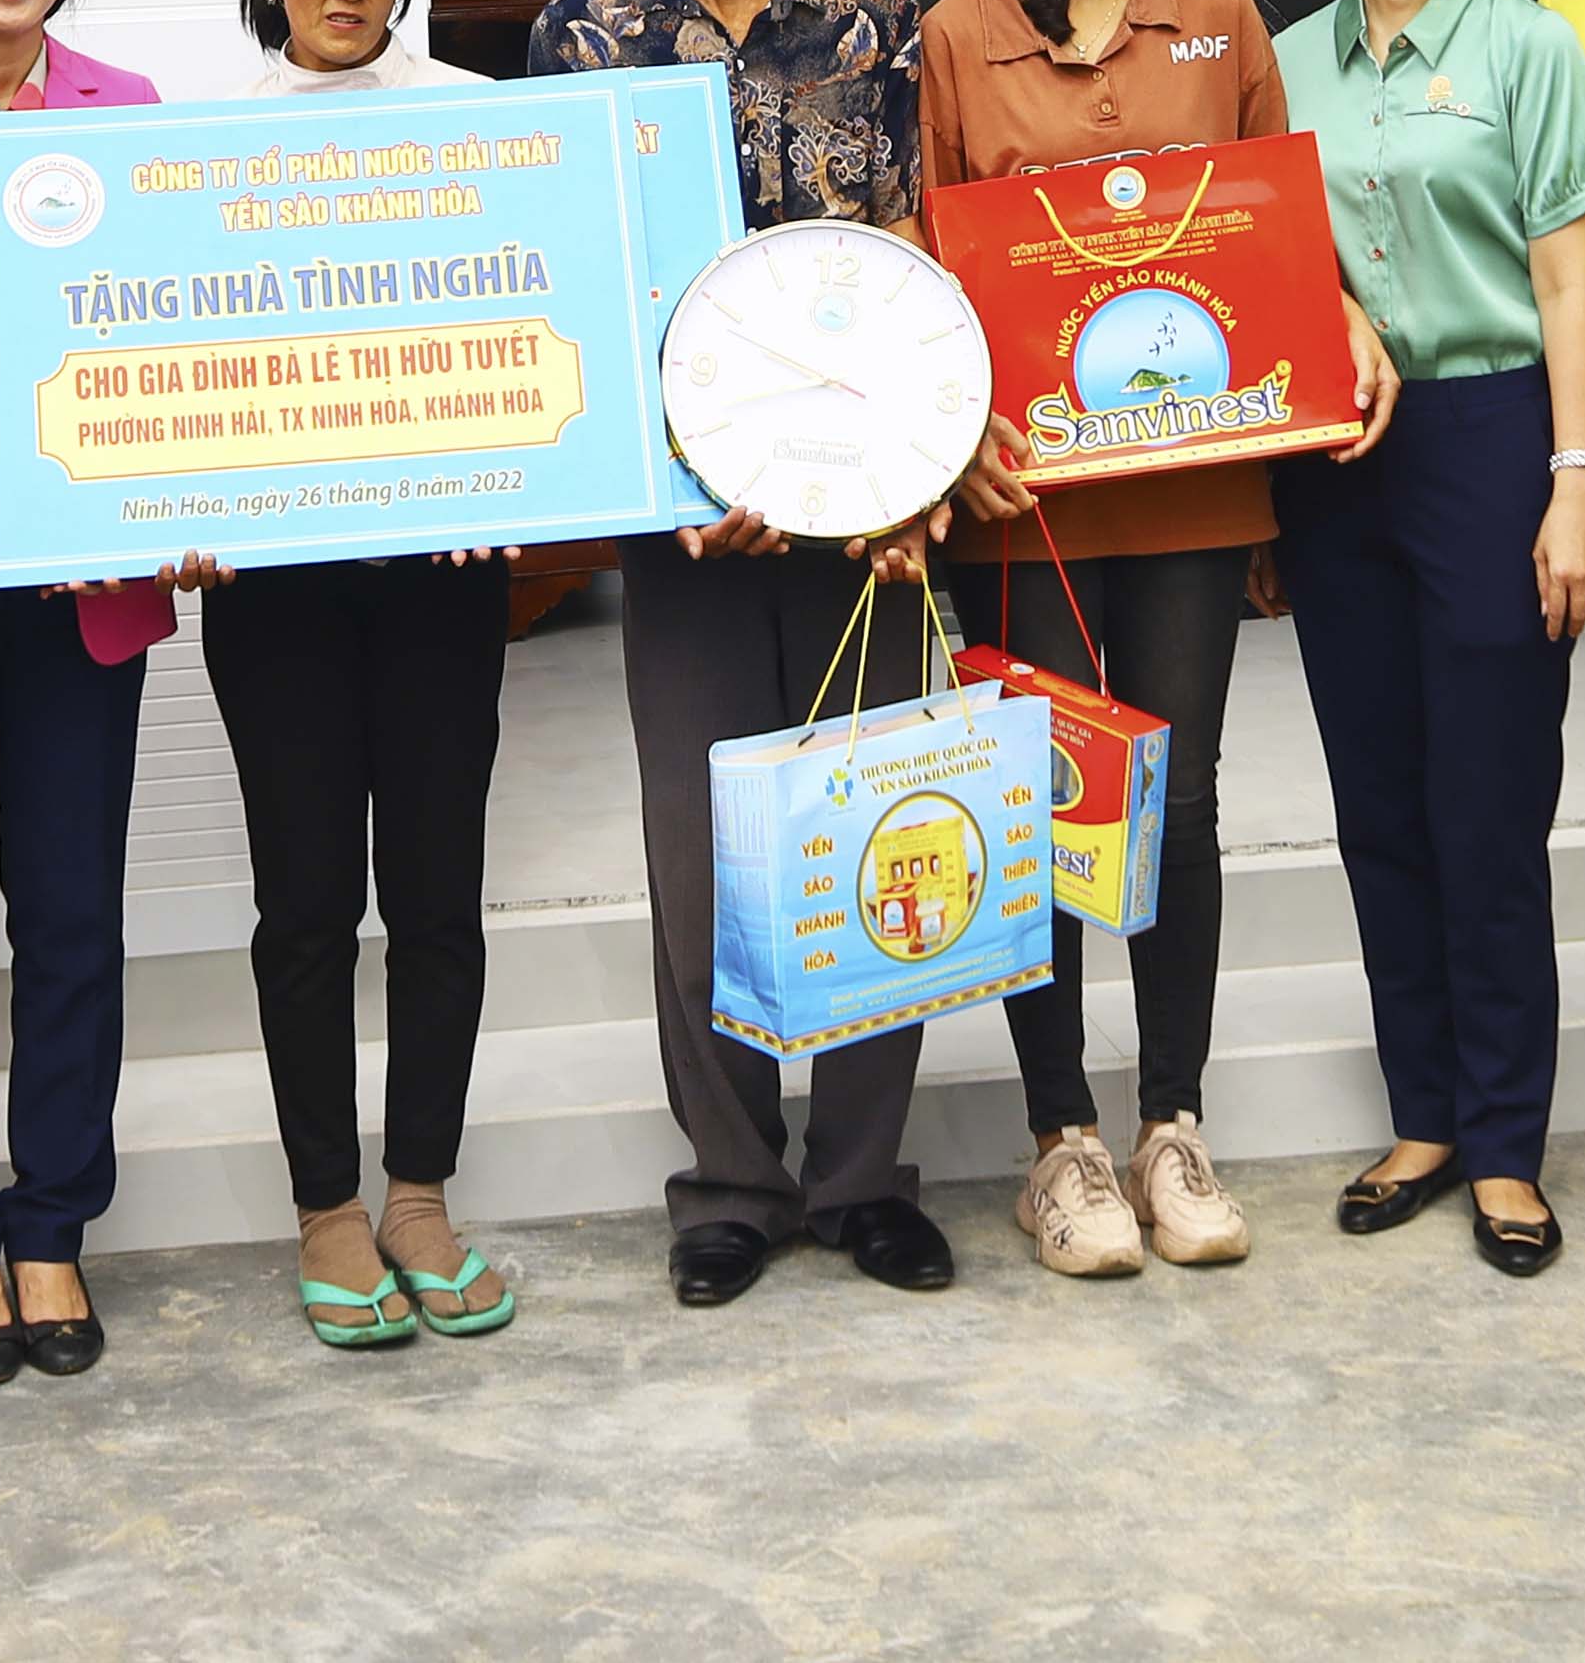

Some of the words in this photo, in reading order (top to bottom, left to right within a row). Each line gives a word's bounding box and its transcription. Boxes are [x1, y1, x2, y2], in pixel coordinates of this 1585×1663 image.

[131, 156, 204, 194] CÔNG
[209, 159, 237, 189] TY
[245, 146, 282, 186] CỔ
[285, 147, 359, 183] PHẦN
[364, 142, 436, 178] NƯỚC
[440, 135, 490, 175] GIẢI
[497, 135, 561, 169] KHÁT
[220, 197, 272, 233] YẾN
[278, 191, 331, 229] SÀO
[336, 188, 424, 225] KHÁNH
[429, 186, 481, 219] HÒA
[814, 250, 862, 289] 12
[64, 277, 180, 338] TẶNG
[191, 263, 285, 317] NHÀ
[294, 261, 398, 309] TÌNH
[411, 246, 550, 305] NGHĨA
[1055, 305, 1085, 358] NƯỚC
[1081, 278, 1114, 309] YẾN
[1116, 269, 1150, 289] SÀO
[1154, 269, 1212, 303] KHÁNH
[1208, 295, 1239, 333] HÒA
[75, 366, 128, 400] CHO
[137, 363, 184, 396] GIA
[191, 353, 258, 391] ĐÌNH
[267, 347, 302, 386] BÀ
[311, 345, 340, 383] LÊ
[348, 346, 392, 386] THỊ
[400, 337, 451, 377] HỮU
[460, 327, 540, 373] TUYẾT
[689, 353, 718, 386] 9
[936, 380, 963, 414] 3
[78, 415, 166, 448] PHƯỜNG
[172, 413, 224, 441] NINH
[230, 402, 274, 439] HẢI,
[279, 408, 304, 433] TX
[311, 403, 362, 429] NINH
[370, 396, 420, 428] HÒA,
[425, 392, 495, 422] KHÁNH
[503, 386, 545, 415] HÒA
[1027, 377, 1293, 463] Sanvinest
[121, 497, 174, 523] Ninh
[180, 491, 231, 522] Hòa,
[235, 488, 292, 516] ngày
[296, 485, 322, 508] 26
[328, 478, 392, 509] tháng
[398, 478, 411, 500] 8
[416, 474, 465, 498] năm
[471, 470, 524, 496] 2022
[799, 482, 827, 516] 6
[871, 780, 897, 796] YẾN
[898, 772, 922, 788] SÀO
[924, 765, 966, 783] KHÁNH
[967, 757, 992, 771] HÒA
[1002, 784, 1032, 808] YẾN
[801, 835, 833, 860] YẾN
[1006, 822, 1033, 845] SÀO
[803, 873, 833, 896] SÀO
[1001, 856, 1037, 883] THIÊN
[1000, 892, 1039, 919] NHIÊN
[794, 907, 846, 940] KHÁNH
[803, 951, 837, 972] HÒA
